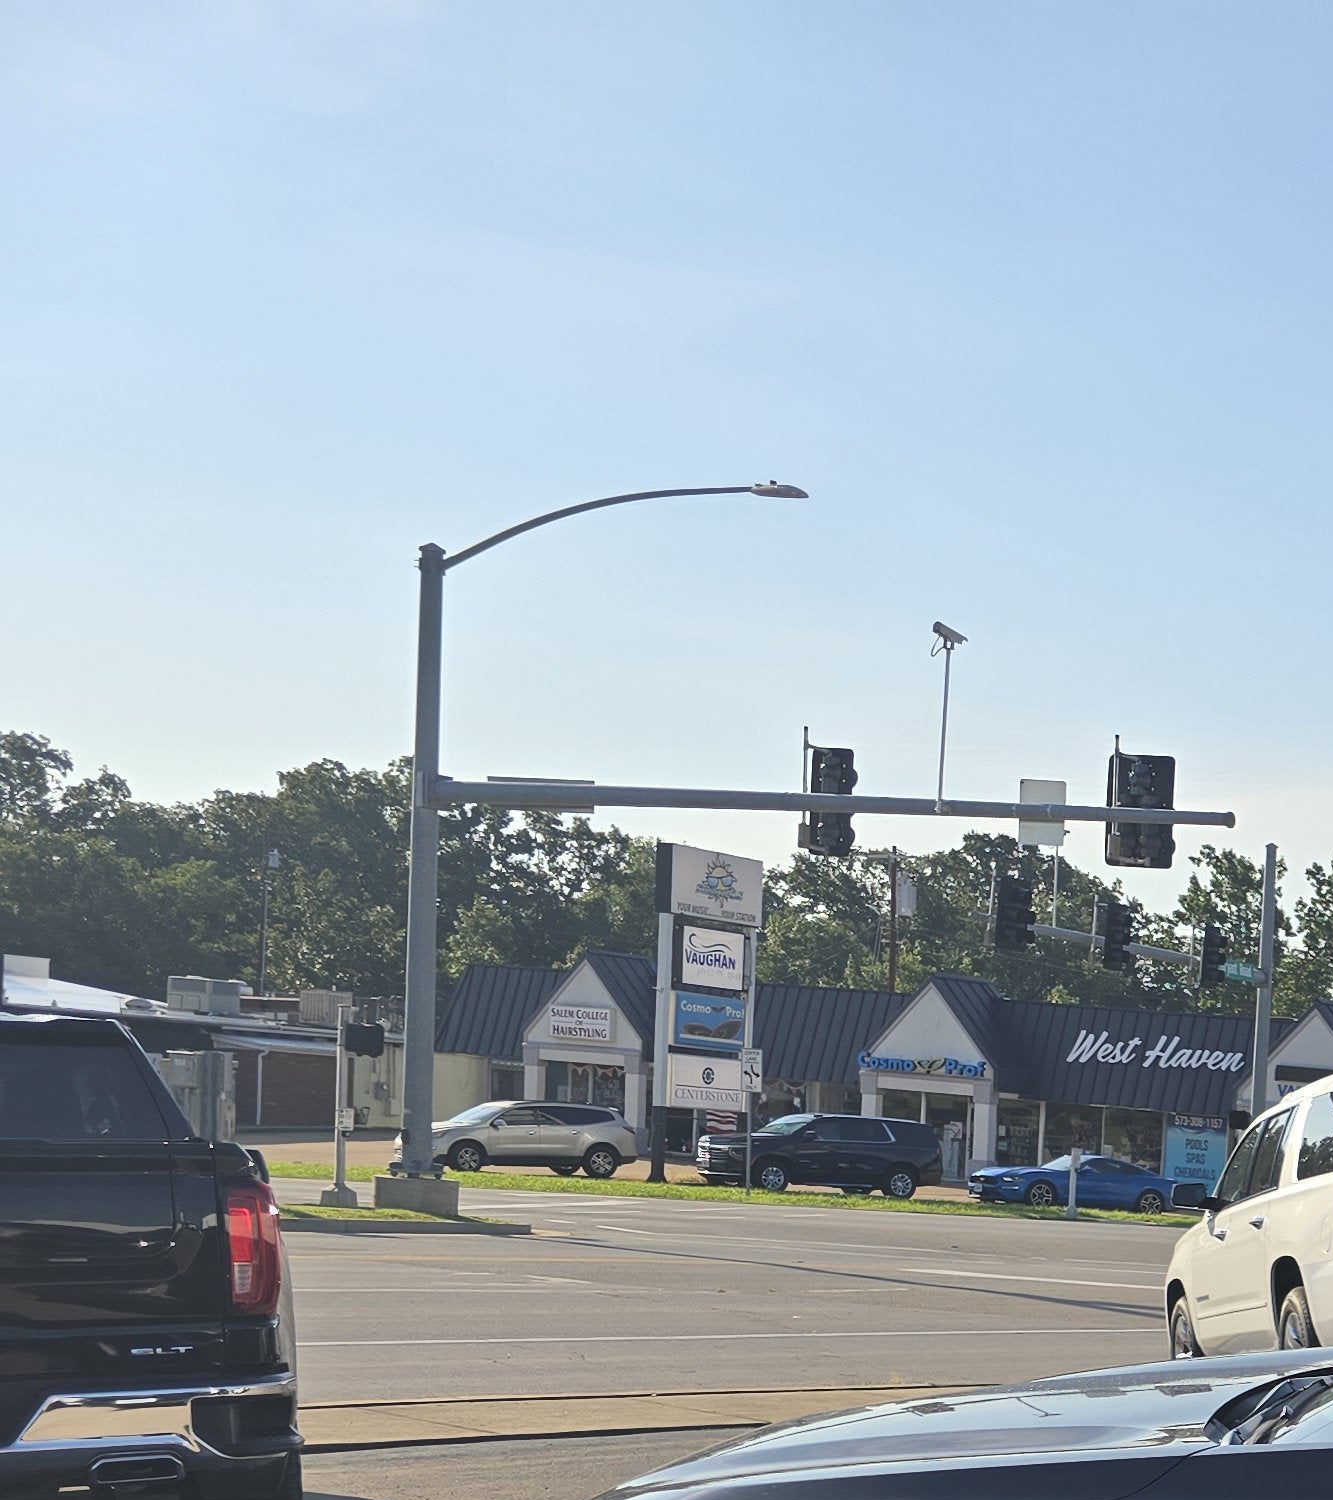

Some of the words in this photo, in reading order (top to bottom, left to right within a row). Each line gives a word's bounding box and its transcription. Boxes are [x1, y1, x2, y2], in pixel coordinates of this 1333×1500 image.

[685, 949, 736, 970] VAUGHAN
[551, 1008, 574, 1018] SALEM
[576, 1010, 608, 1020] COLLEGE
[681, 1000, 712, 1014] Cosmo
[552, 1025, 607, 1038] HAIRSTYLING
[1066, 1030, 1142, 1063] West
[1142, 1035, 1245, 1072] Haven
[858, 1051, 917, 1072] Cosmo
[944, 1058, 987, 1078] Prof
[675, 1088, 741, 1102] CENTERSTONE
[1185, 1139, 1208, 1151] POOLS
[1186, 1153, 1206, 1164] SPAS
[1174, 1166, 1216, 1180] CHEMICALS
